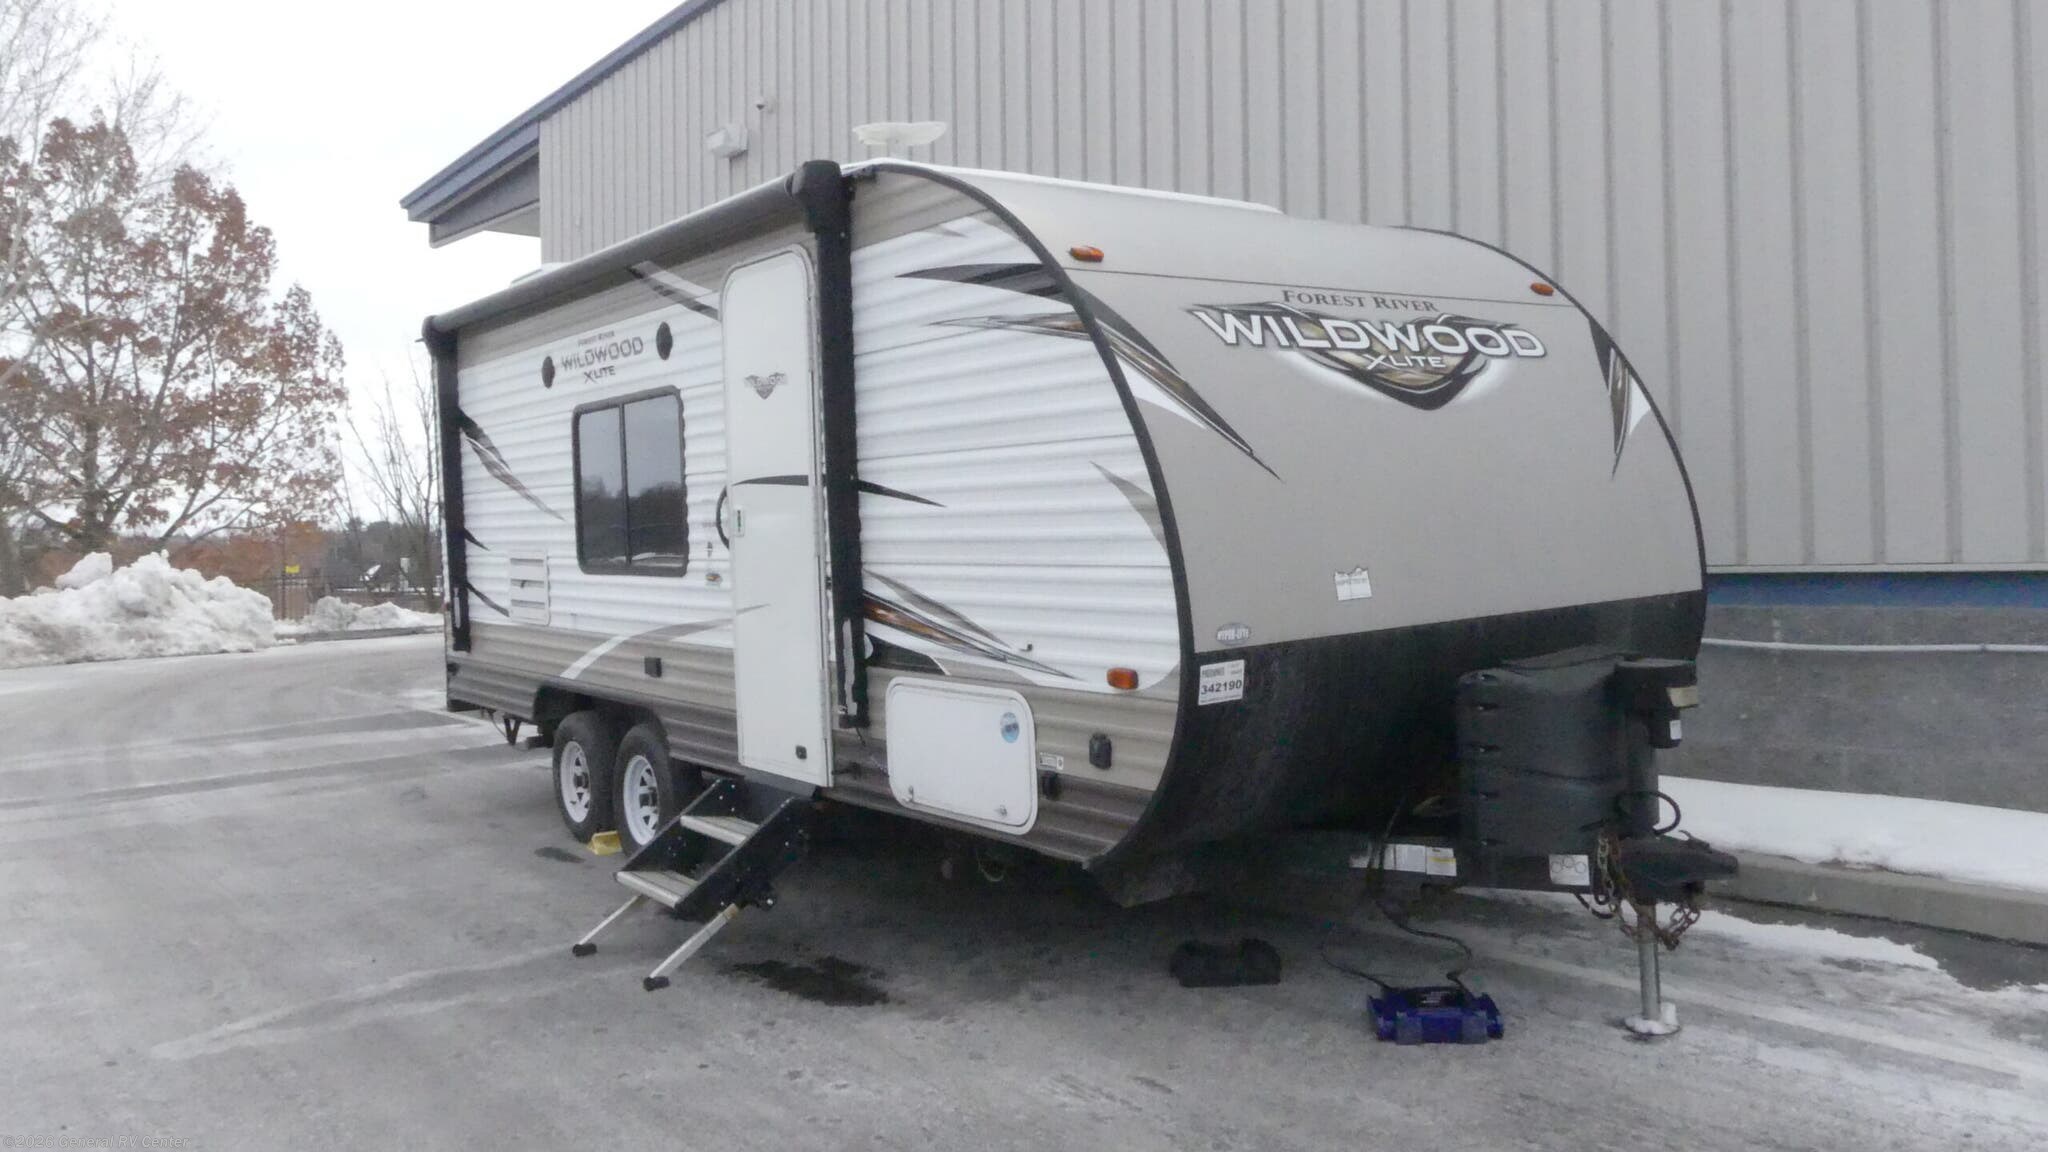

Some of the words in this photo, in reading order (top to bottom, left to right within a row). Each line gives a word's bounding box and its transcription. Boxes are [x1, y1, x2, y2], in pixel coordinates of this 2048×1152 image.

[1282, 290, 1367, 308] FOREST
[1371, 296, 1440, 313] RIVER
[1191, 309, 1547, 358] WILDWOOD
[561, 336, 644, 371] WILDWOOD
[1200, 679, 1242, 695] 342190
